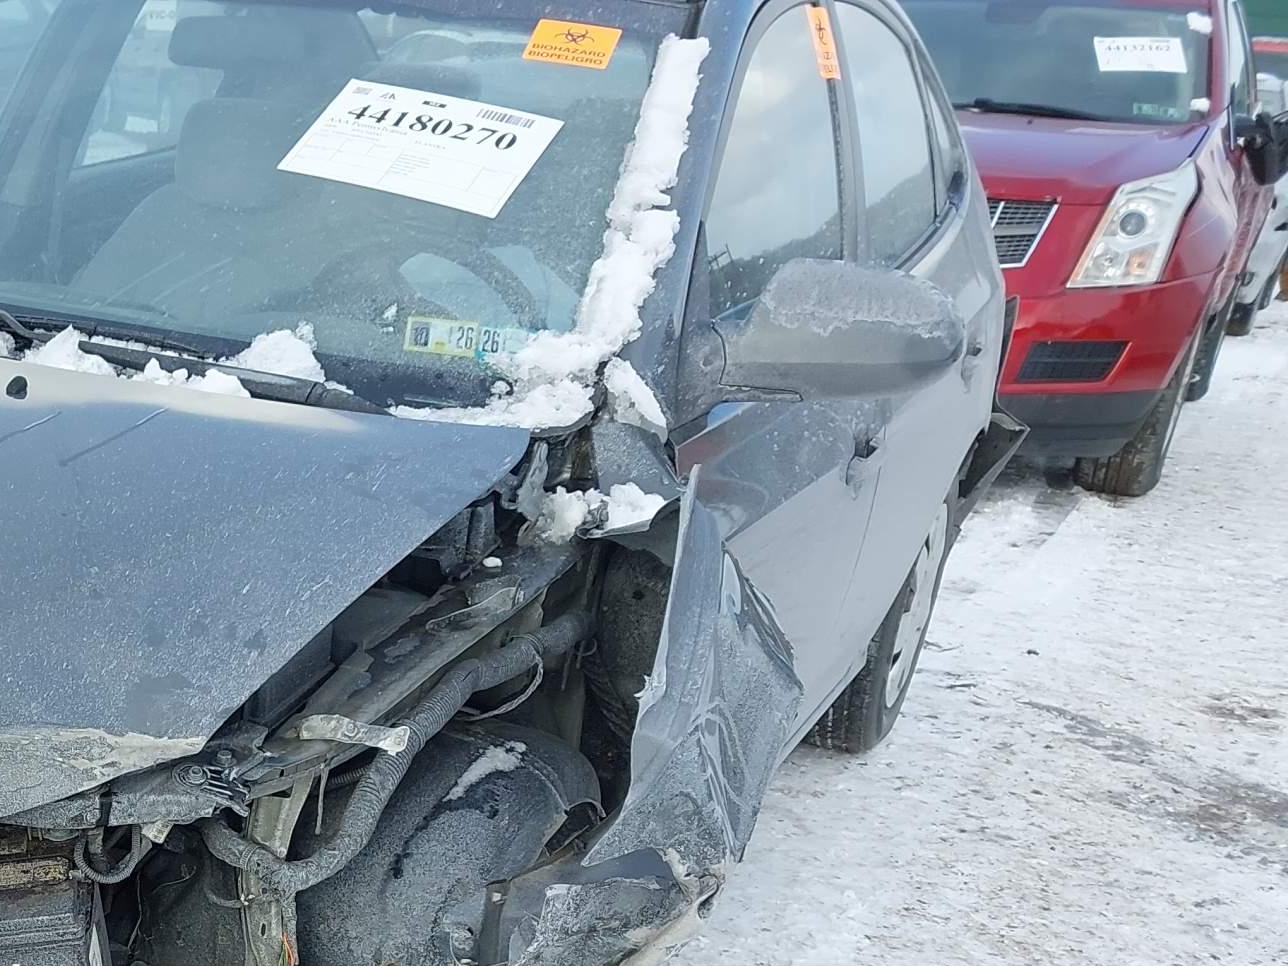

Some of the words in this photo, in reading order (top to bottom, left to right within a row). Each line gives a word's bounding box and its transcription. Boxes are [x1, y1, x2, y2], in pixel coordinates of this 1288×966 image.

[528, 50, 603, 65] BIOPELIGRO
[531, 43, 606, 58] BIOHAZARD
[347, 103, 518, 151] 44180270
[456, 326, 474, 350] 26
[481, 328, 500, 353] 26
